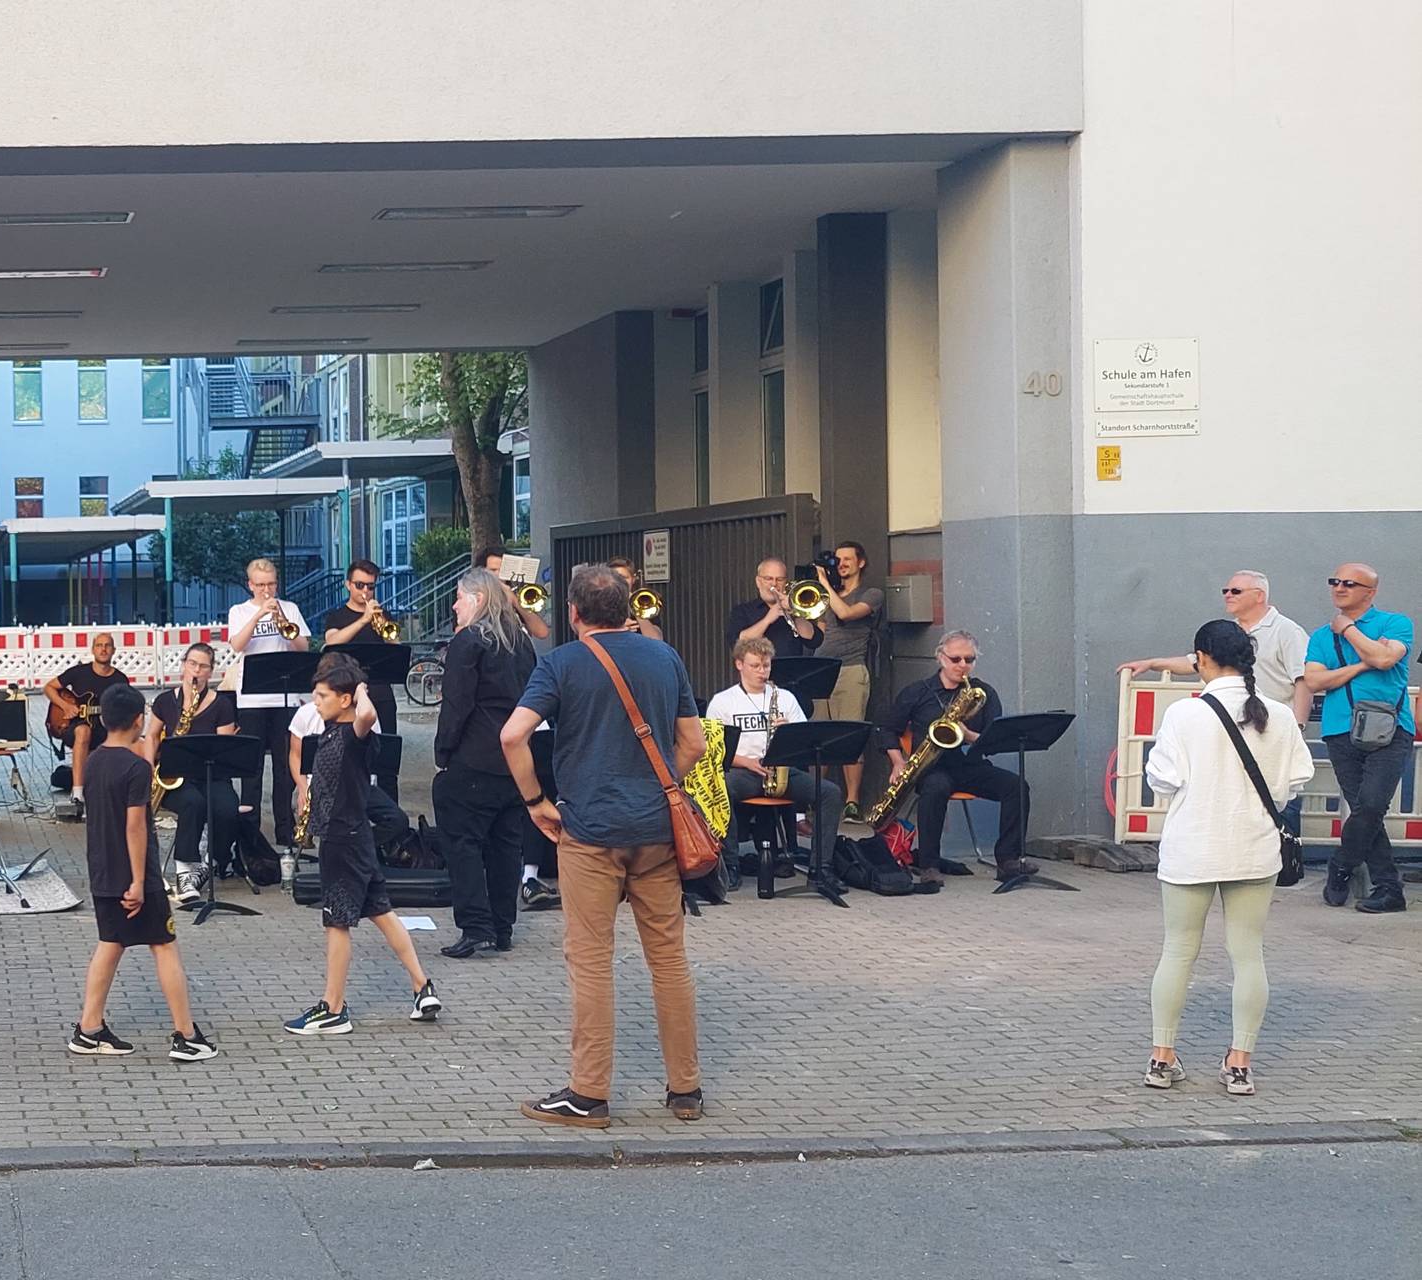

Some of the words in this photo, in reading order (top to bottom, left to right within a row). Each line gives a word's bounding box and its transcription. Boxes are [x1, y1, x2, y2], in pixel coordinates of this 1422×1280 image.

[1102, 370, 1137, 380] Schule
[1140, 371, 1157, 379] am
[1160, 368, 1192, 379] Hafen
[1024, 370, 1062, 397] 40
[1101, 423, 1131, 432] Standort
[1133, 422, 1195, 432] Scharnhorststraße
